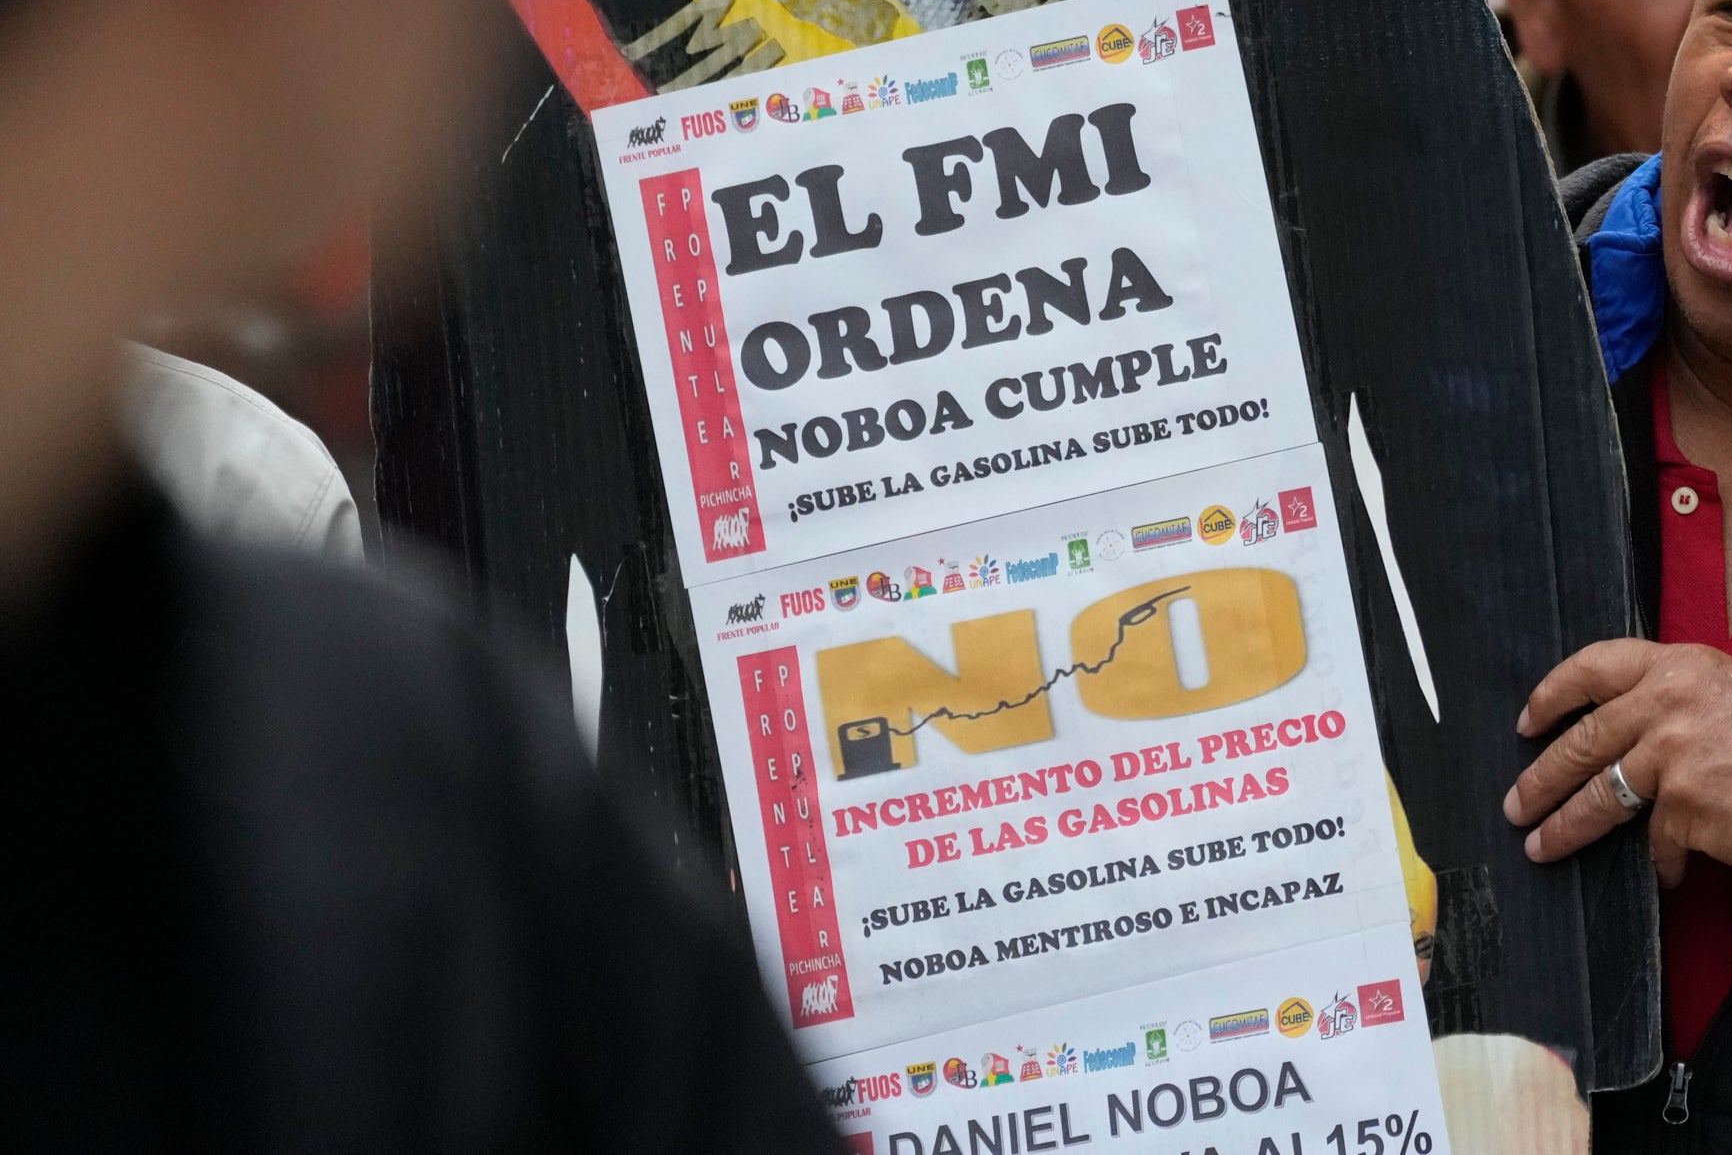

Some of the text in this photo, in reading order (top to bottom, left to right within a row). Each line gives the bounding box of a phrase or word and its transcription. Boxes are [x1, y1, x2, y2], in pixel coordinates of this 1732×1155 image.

[1101, 37, 1131, 52] CUBE
[730, 99, 759, 111] UNE
[868, 93, 901, 110] UNAPE
[681, 109, 727, 141] FUOS
[618, 144, 682, 164] FRENTE POPULAR
[711, 103, 1151, 276] EL FMI
[741, 248, 1173, 390] ORDENA
[754, 333, 1227, 469] NOBOA CUMPLE
[788, 398, 1269, 522] ¡SUBE LA GASOLINA SUBE TODO!
[700, 485, 752, 509] PICHINCHA
[1203, 518, 1233, 534] CUBE
[830, 578, 858, 589] UNE
[944, 574, 965, 589] FESE
[969, 574, 1001, 589] UNAPE
[780, 587, 826, 619] FUOS
[717, 622, 780, 641] FRENTE POPULAR
[816, 567, 1308, 780] NO
[833, 710, 1347, 836] INCREMENTO DEL PRECIO
[906, 768, 1290, 870] DE LAS GASOLINAS
[862, 816, 1346, 938] ¡SUBE LA GASOLINA SUBE TODO!
[879, 872, 1344, 986] NOBOA MENTIROSO E INCAPAZ
[789, 953, 842, 976] PICHINCHA
[1280, 1011, 1311, 1026] CUBE
[906, 1063, 936, 1074] UNE
[1021, 1063, 1042, 1077] FESE
[1046, 1063, 1079, 1078] UNAPE
[857, 1072, 902, 1103] FUOS
[889, 1062, 1313, 1155] DANIEL NOBOA
[1326, 1109, 1433, 1155] 15%
